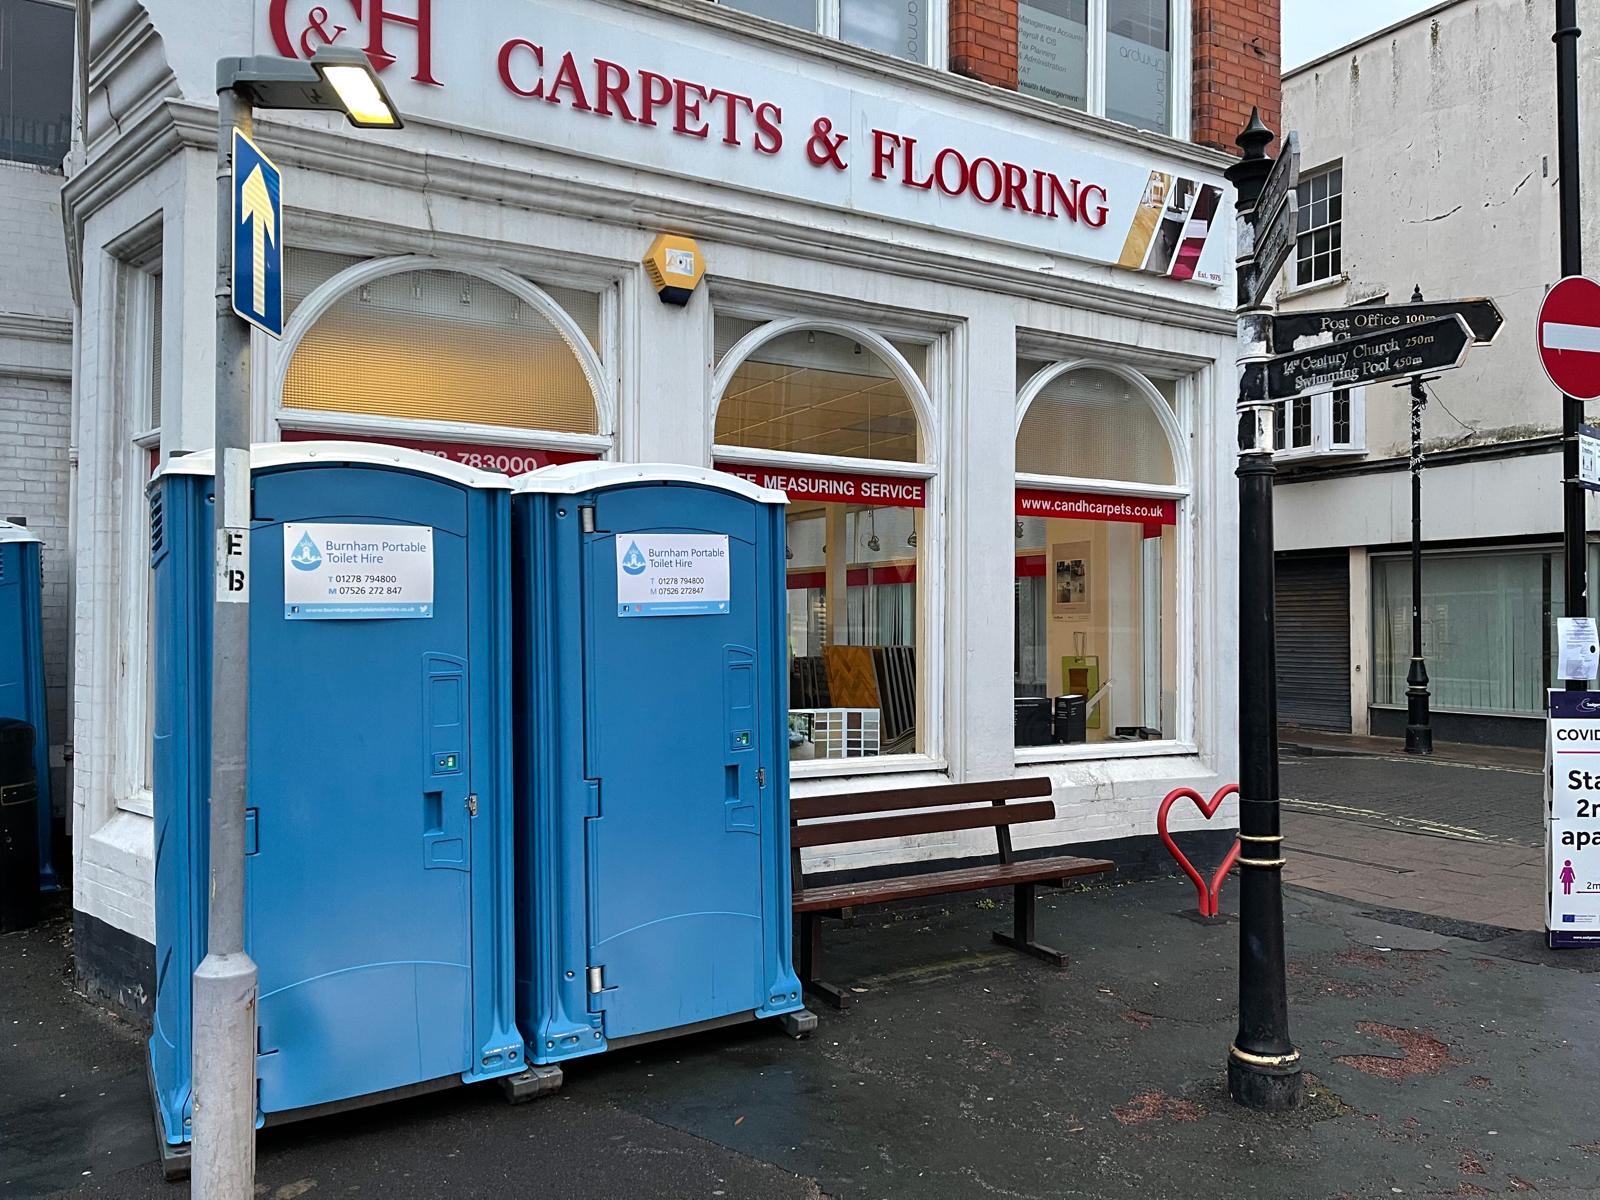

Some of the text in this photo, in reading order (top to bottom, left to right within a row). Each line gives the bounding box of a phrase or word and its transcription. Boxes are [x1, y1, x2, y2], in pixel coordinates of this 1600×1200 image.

[498, 38, 1109, 229] CARPETS & FLOORING
[1320, 317, 1350, 330] Post
[1354, 314, 1400, 328] Office
[1301, 352, 1349, 370] Century
[1353, 337, 1400, 358] Church
[1404, 334, 1435, 348] 250m
[1295, 356, 1423, 391] Swimming Pool 450m
[457, 452, 538, 474] 783000
[764, 475, 855, 496] MEASURING
[861, 481, 922, 500] SERVICE
[1021, 498, 1163, 518] www.candhcarpets.co.uk
[227, 534, 243, 556] E
[326, 541, 427, 553] Burnham Portable
[648, 548, 725, 558] Burnham Portable
[326, 552, 384, 564] Toilet Hire
[649, 559, 693, 568] Toilet Hire
[228, 569, 245, 591] B
[335, 575, 362, 583] 01278
[364, 575, 397, 583] 794800
[658, 577, 679, 585] 01278
[680, 577, 705, 585] 794800
[328, 587, 402, 595] M 07526 272 847
[680, 587, 704, 595] 272847
